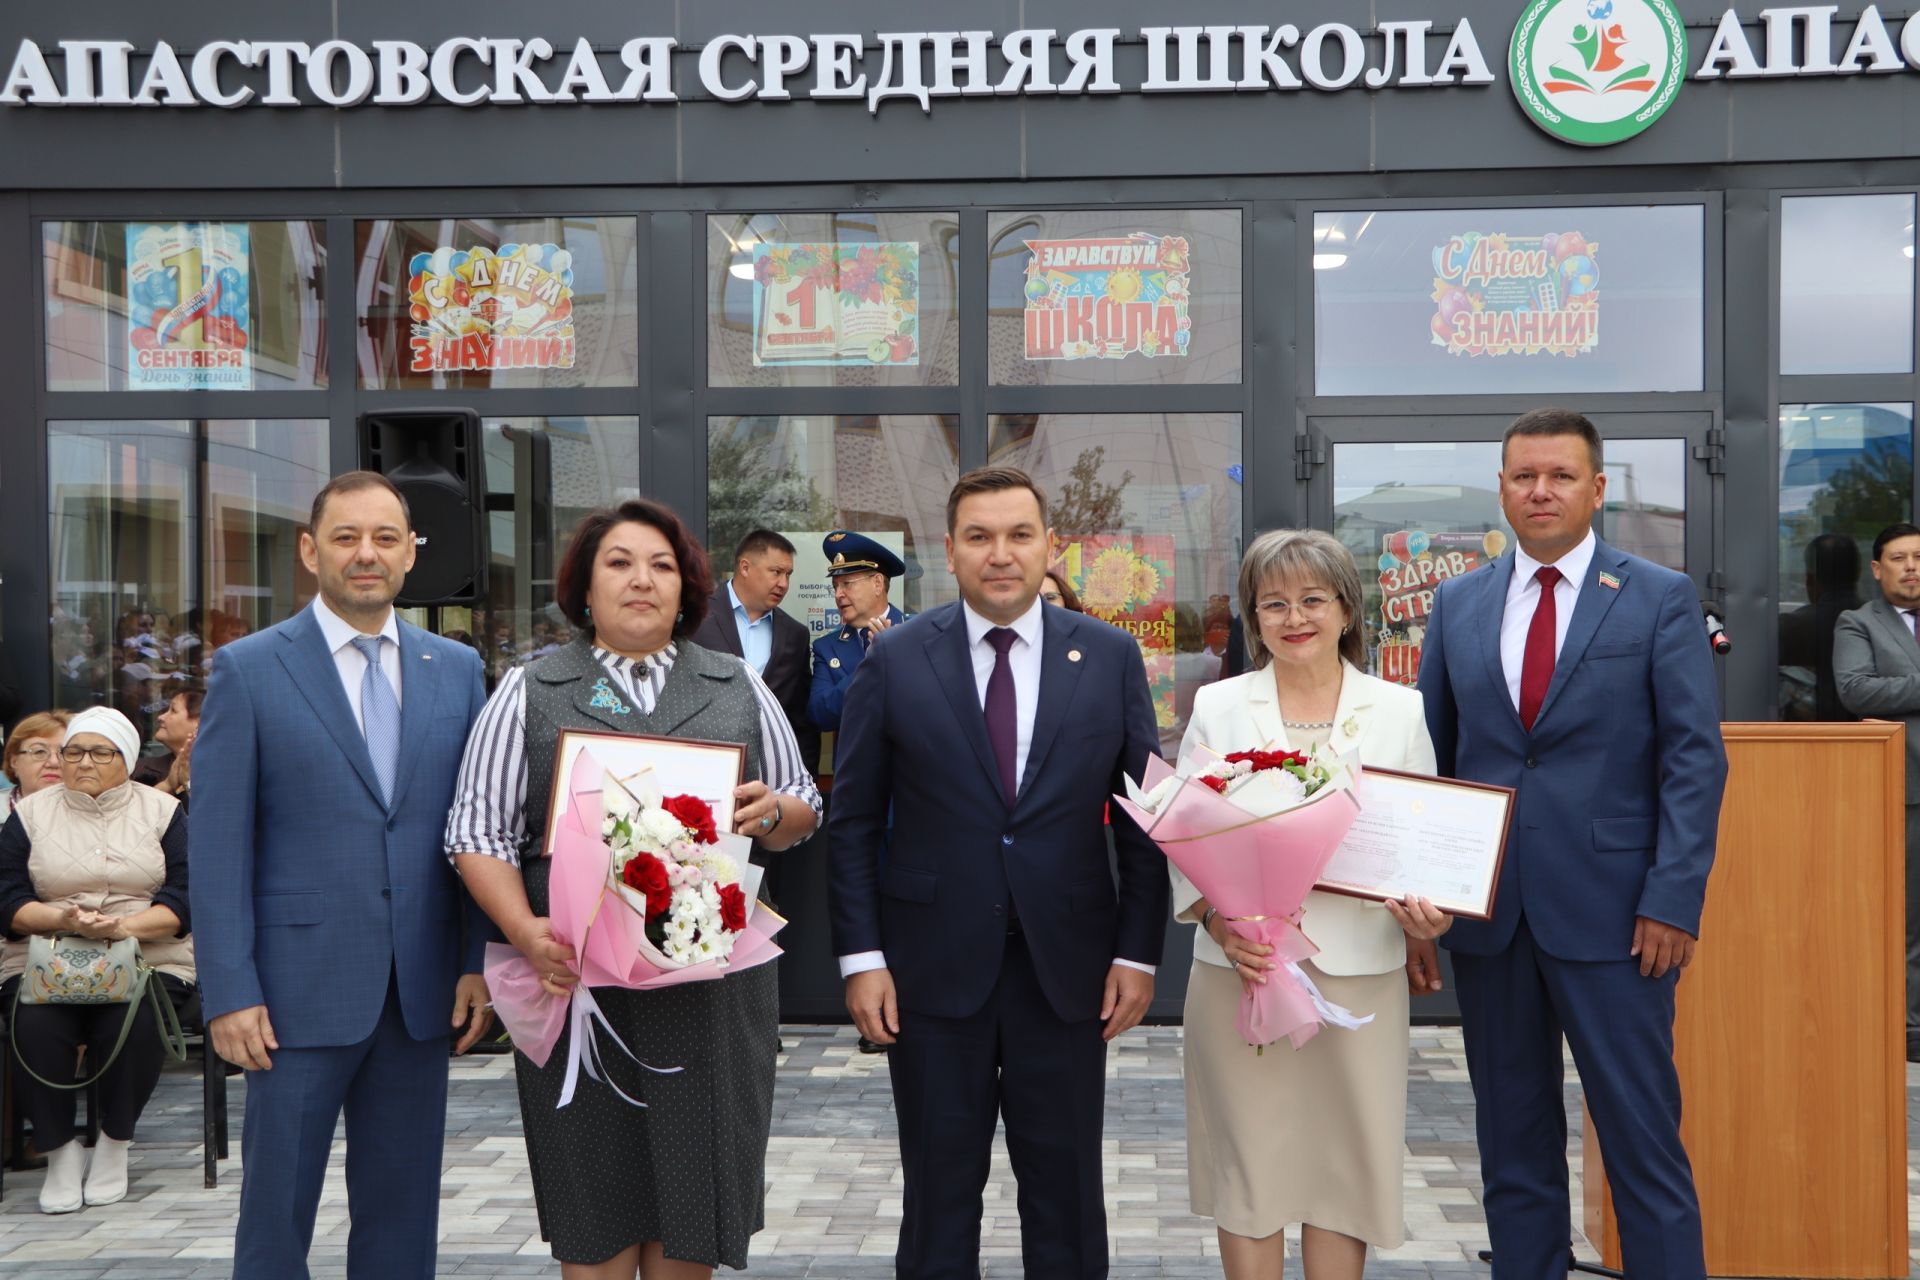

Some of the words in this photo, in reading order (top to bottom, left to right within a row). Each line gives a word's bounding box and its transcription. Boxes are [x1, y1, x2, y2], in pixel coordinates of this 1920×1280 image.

[0, 36, 677, 107] АПАСТОВСКАЯ
[698, 27, 1121, 114] СРЕДНЯЯ
[1138, 16, 1495, 94] ШКОЛА
[1442, 239, 1463, 278] С
[1464, 237, 1547, 285] Днем
[423, 280, 448, 308] С
[471, 258, 562, 306] ДНЕМ
[787, 279, 816, 329] 1
[1025, 295, 1179, 358] ШКОЛА
[1454, 304, 1597, 346] ЗНАНИЙ!
[138, 351, 243, 368] СЕНТЯБРЯ
[411, 333, 574, 370] ЗНАНИЙ!
[141, 370, 181, 383] День
[184, 370, 244, 389] знаний
[1386, 551, 1475, 592] ЗДРАВ-
[826, 613, 841, 625] 19
[1387, 588, 1437, 622] СТВ
[809, 620, 824, 632] 18
